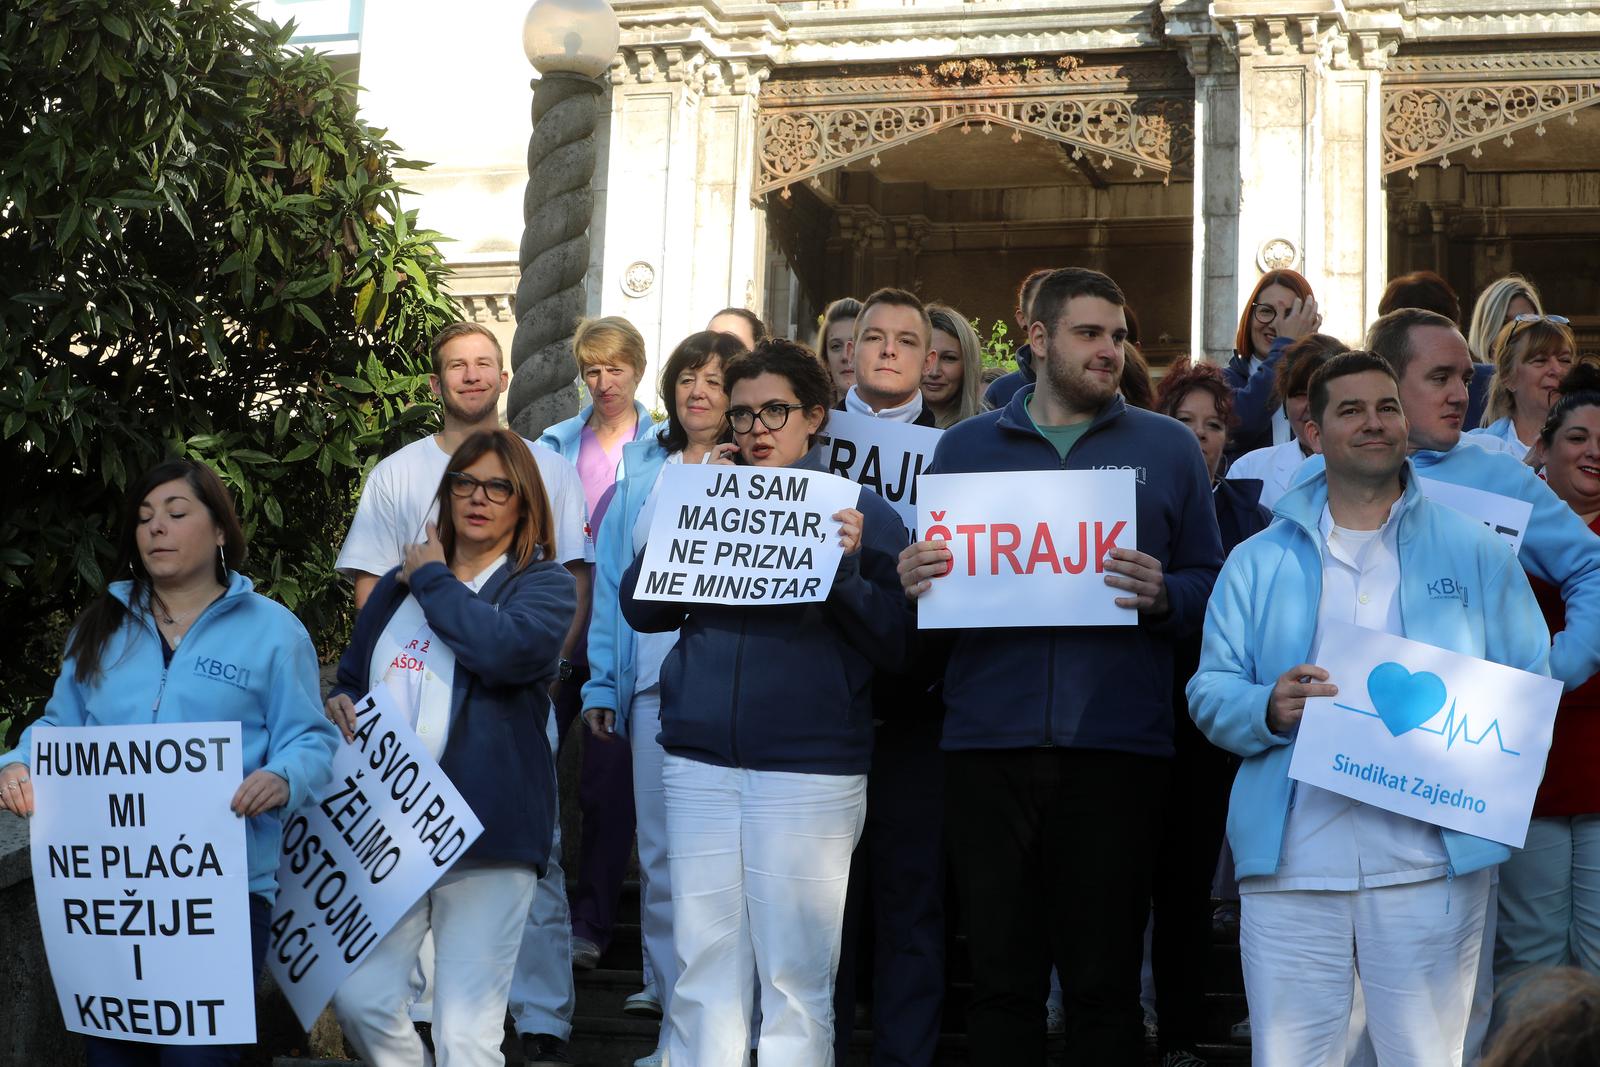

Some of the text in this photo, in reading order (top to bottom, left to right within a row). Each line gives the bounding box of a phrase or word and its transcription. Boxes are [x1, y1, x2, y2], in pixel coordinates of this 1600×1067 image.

[706, 473, 809, 502] JA SAM
[677, 505, 827, 543] MAGISTAR,
[925, 511, 1127, 578] ŠTRAJK
[668, 539, 813, 570] NE PRIZNA
[645, 571, 821, 599] ME MINISTAR
[390, 654, 424, 671] AŠOJ
[36, 738, 231, 776] HUMANOST
[370, 731, 431, 814] SVOJ
[412, 794, 466, 867] RAD
[1333, 753, 1486, 815] Sindikat Zajedno
[109, 793, 145, 827] MI
[320, 769, 401, 884] ŽELIMO
[49, 834, 223, 879] NE PLAĆA
[281, 811, 378, 963] OSTOJNU
[64, 889, 215, 936] REŽIJE
[271, 888, 320, 984] AĆU
[134, 944, 143, 981] I
[75, 994, 225, 1037] KREDIT
